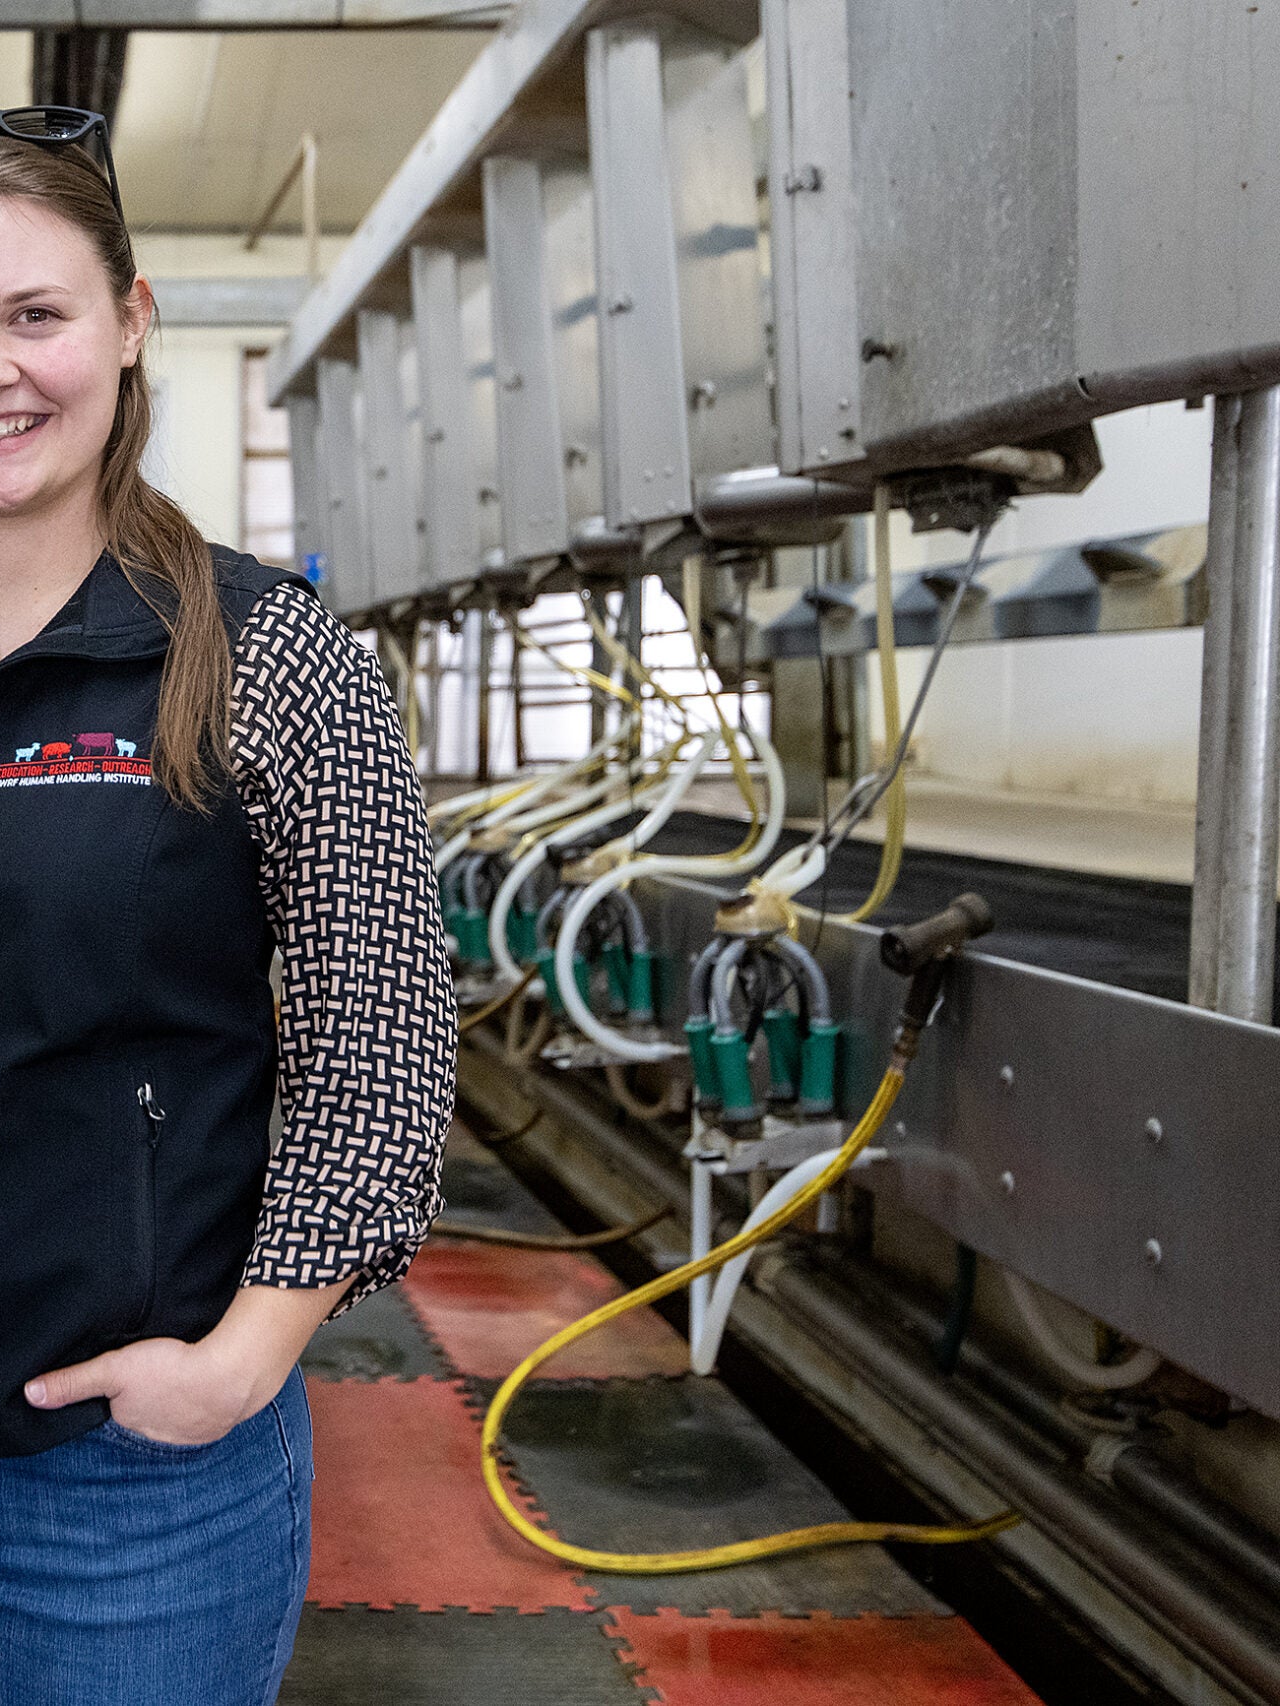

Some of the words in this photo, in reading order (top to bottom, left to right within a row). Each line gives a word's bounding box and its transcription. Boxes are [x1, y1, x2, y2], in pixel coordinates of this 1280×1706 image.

[19, 775, 55, 786] HUMANE
[56, 773, 102, 784] HANDLING
[103, 773, 151, 785] INSTITUTE
